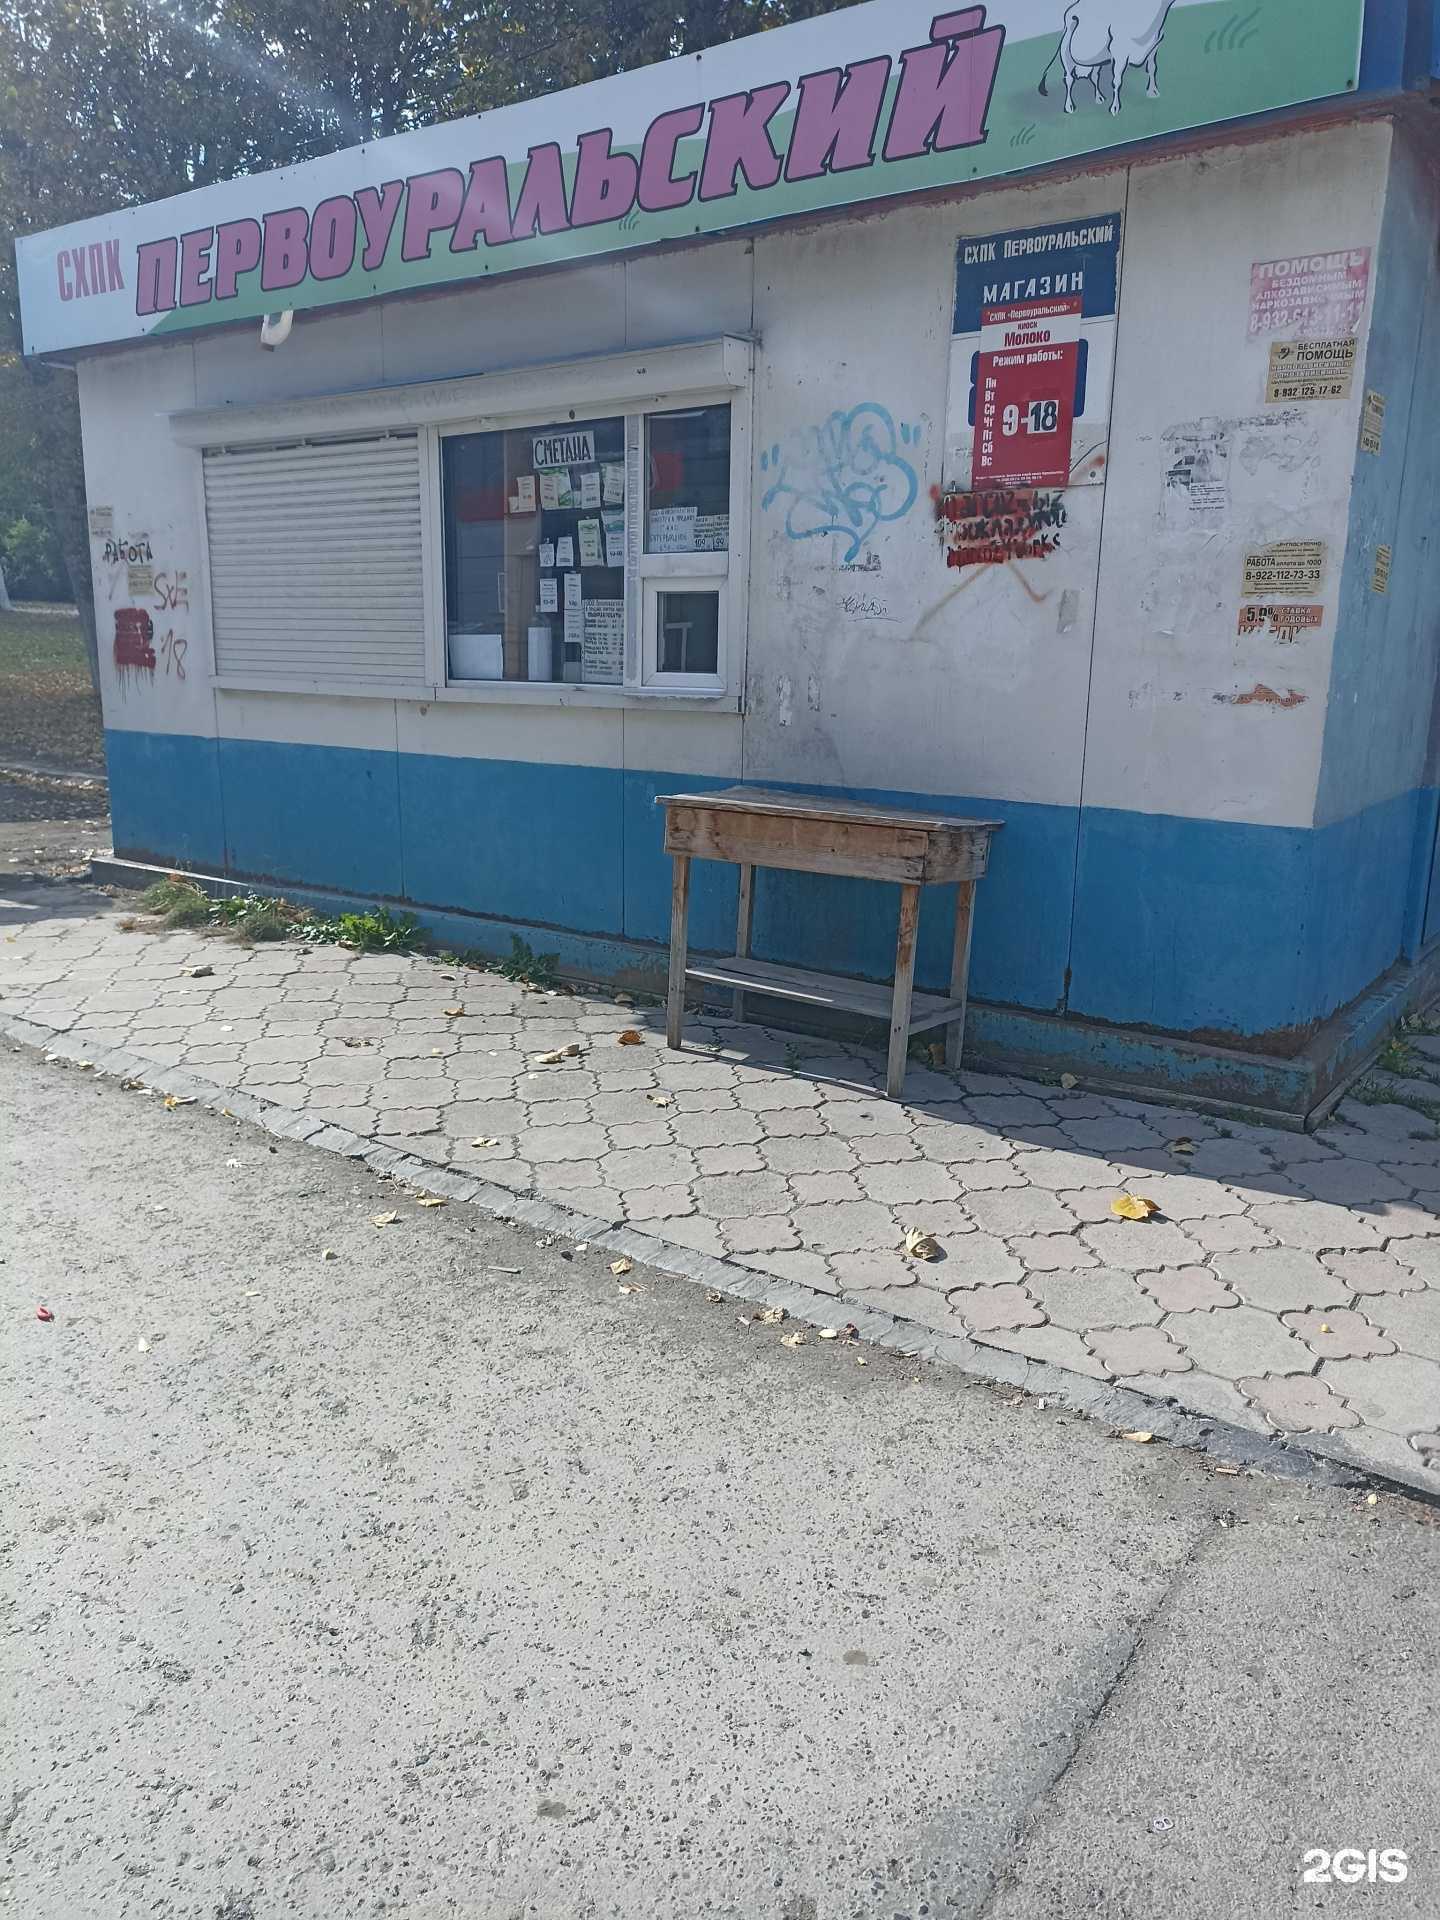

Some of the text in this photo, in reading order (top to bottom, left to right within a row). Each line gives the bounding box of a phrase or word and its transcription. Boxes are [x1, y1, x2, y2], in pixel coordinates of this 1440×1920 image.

[57, 4, 1006, 317] СХПК ПЕРВОУРАЛЬСКИЙ
[964, 219, 1114, 265] СХПК ПЕРВОУРАЛЬСКИЙ
[1259, 251, 1365, 279] ПОМОЩЬ
[983, 271, 1083, 304] МАГАЗИН
[1004, 330, 1051, 347] Молоко
[1298, 339, 1355, 351] БЕСПЛАТНАЯ
[992, 350, 1064, 367] Режим работы:
[1296, 349, 1353, 361] ПОМОЩЬ
[985, 377, 997, 389] Пн
[984, 391, 995, 401] Вт
[984, 403, 995, 415] Ср
[983, 417, 994, 428] Чт
[982, 430, 993, 441] Пт
[534, 438, 591, 466] СМЕТАНА
[982, 442, 993, 454] Сб
[981, 455, 993, 466] Вс
[1246, 558, 1276, 567] РАБОТА
[1245, 570, 1320, 580] 8-922-112-73-33
